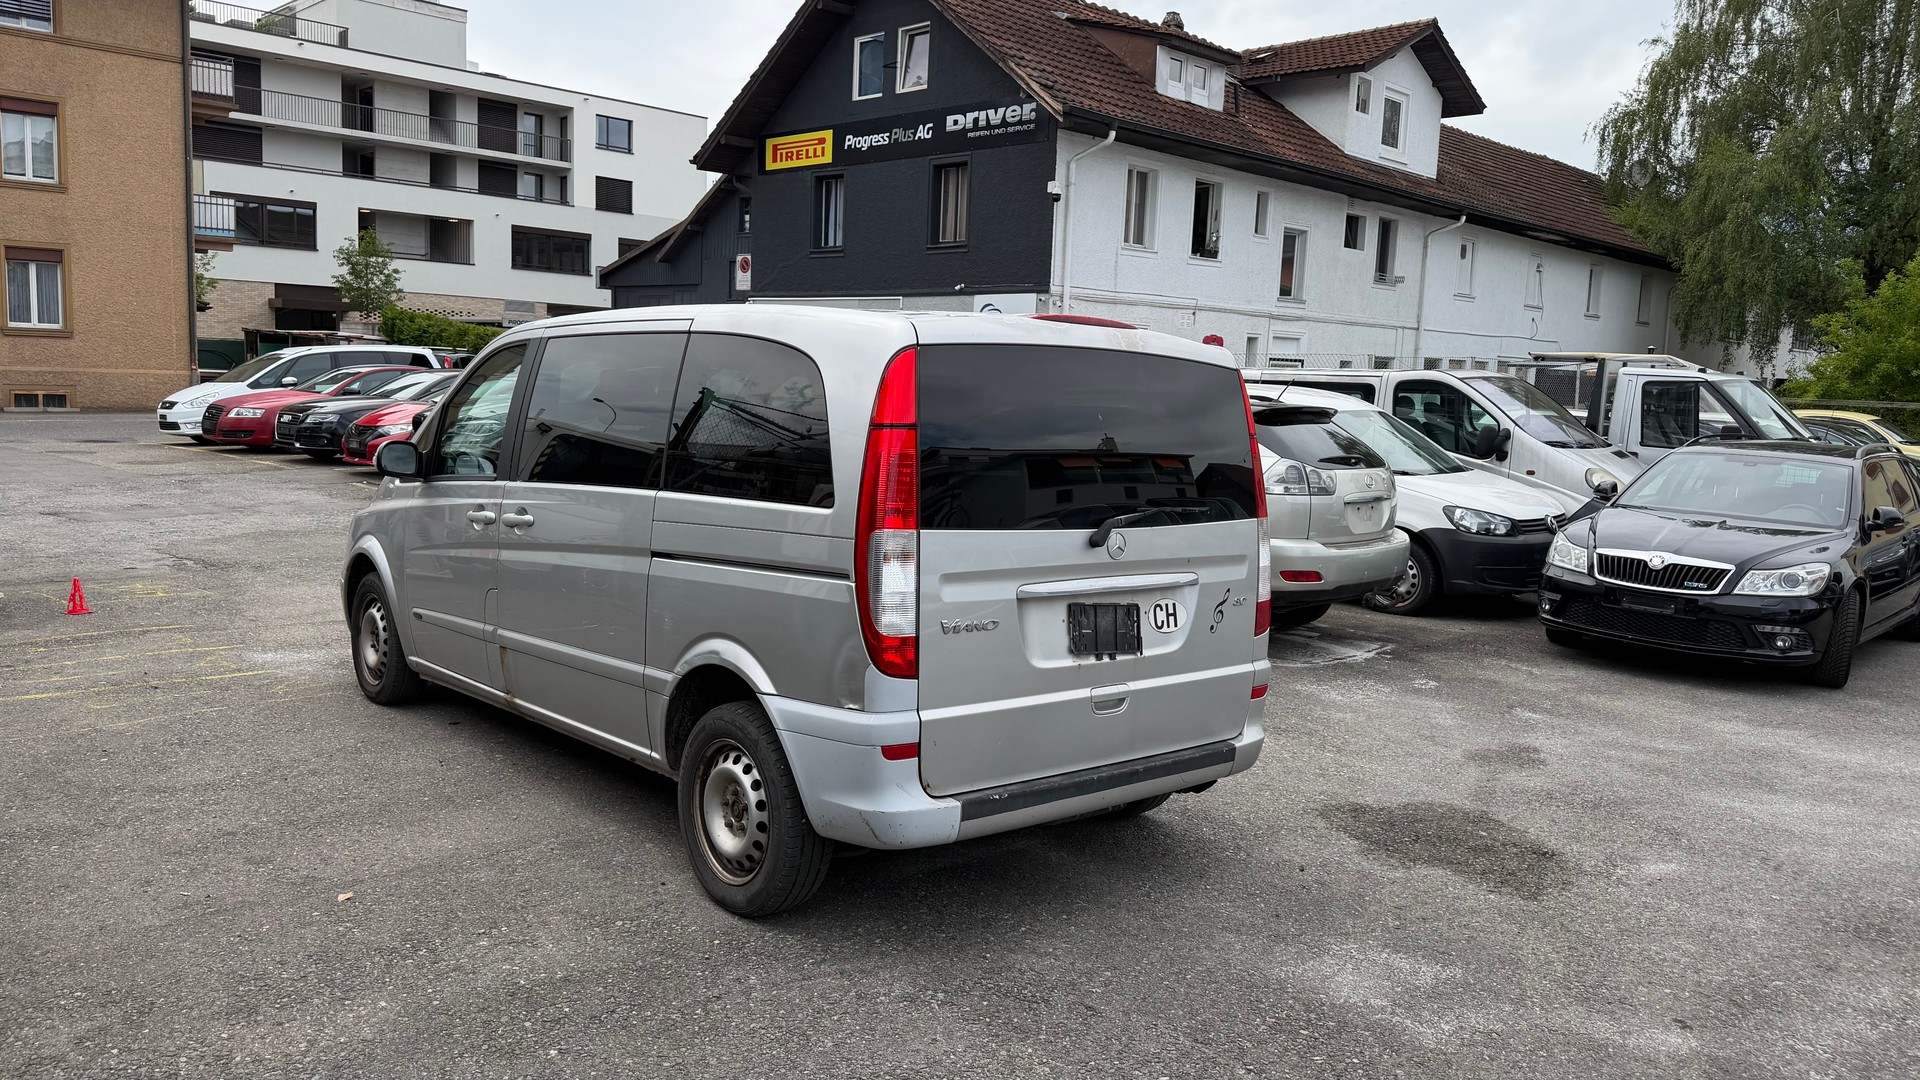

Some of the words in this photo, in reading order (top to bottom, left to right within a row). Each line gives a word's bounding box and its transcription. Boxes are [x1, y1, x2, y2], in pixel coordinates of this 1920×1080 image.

[844, 132, 889, 151] Progress
[891, 127, 914, 143] Plus
[915, 122, 934, 141] AG
[967, 129, 990, 138] REIFEN
[991, 127, 1006, 136] UND
[1007, 123, 1036, 134] SERVICE
[772, 136, 826, 164] PIRELLI
[940, 618, 1000, 635] VIANO
[1153, 602, 1178, 630] CH
